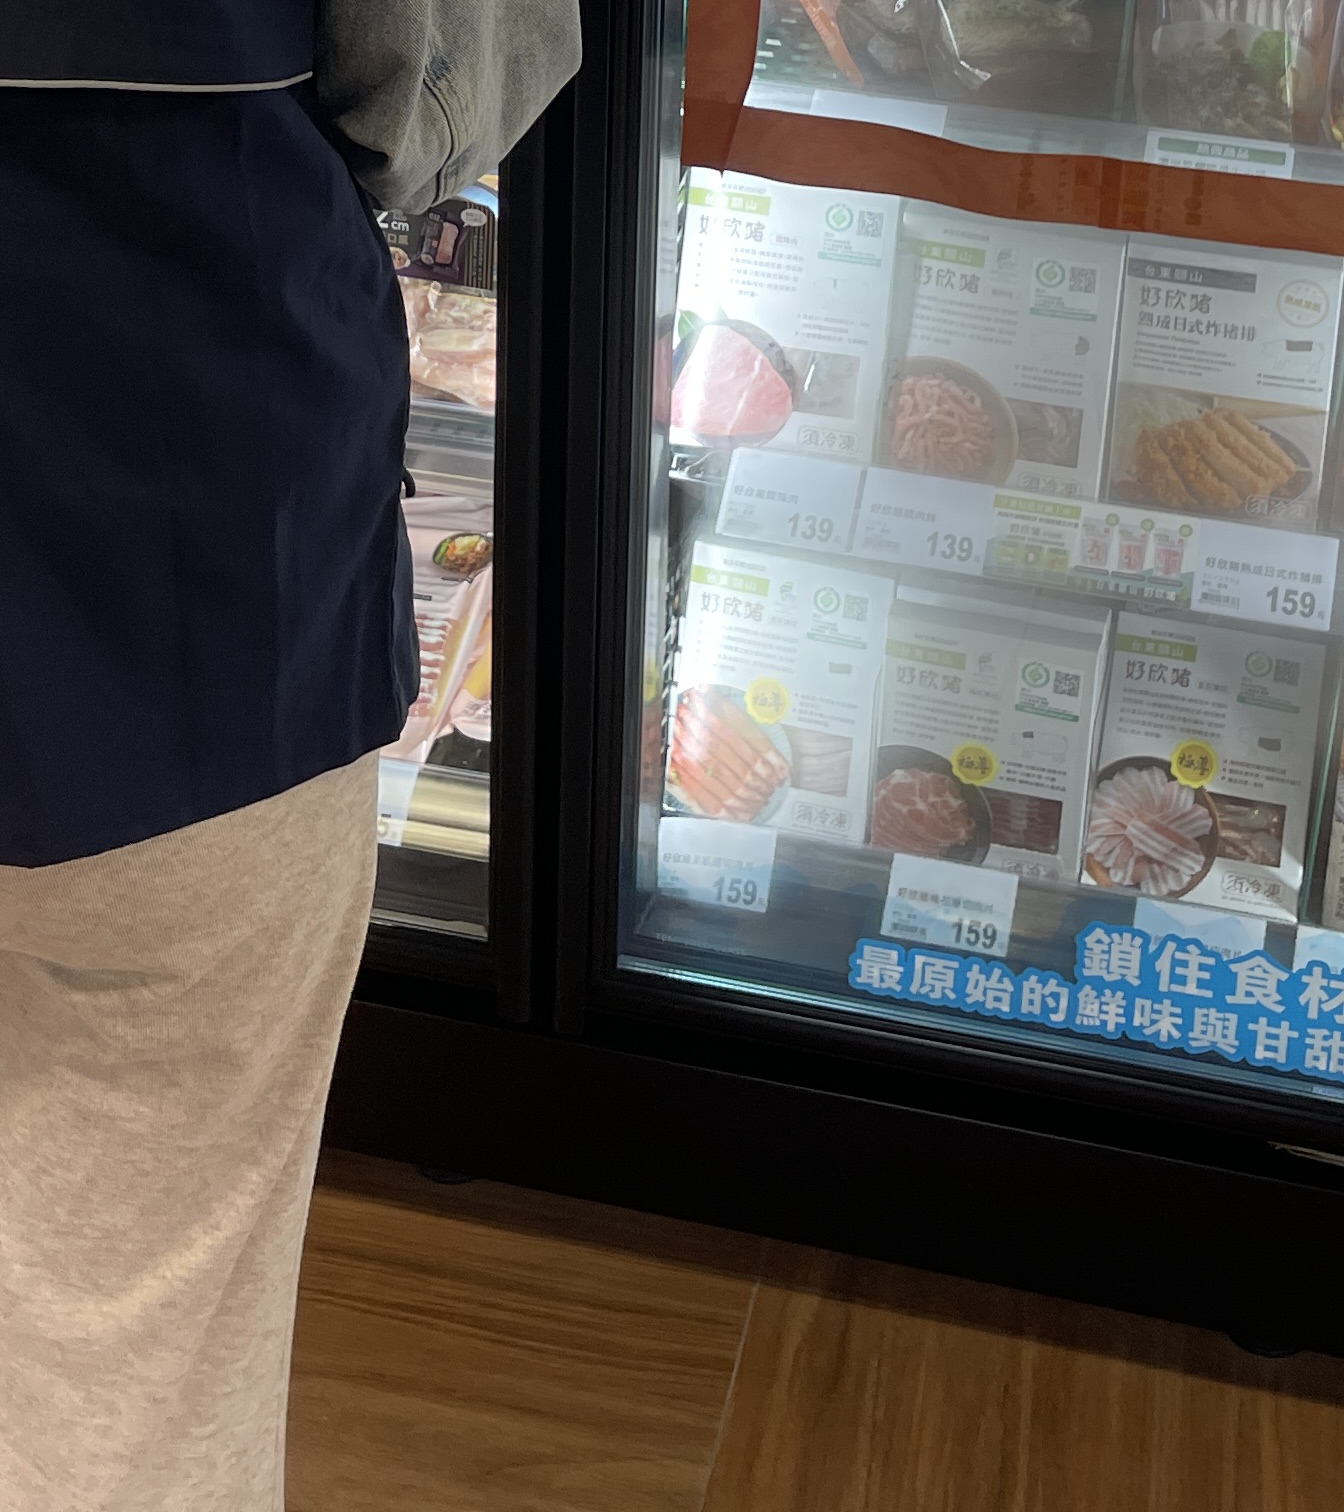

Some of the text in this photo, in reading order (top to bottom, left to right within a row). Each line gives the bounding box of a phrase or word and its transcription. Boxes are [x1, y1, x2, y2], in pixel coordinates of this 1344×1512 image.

[786, 511, 835, 543] 139
[925, 530, 975, 563] 139
[1264, 586, 1317, 619] 159
[712, 876, 759, 907] 159
[952, 918, 998, 950] 159
